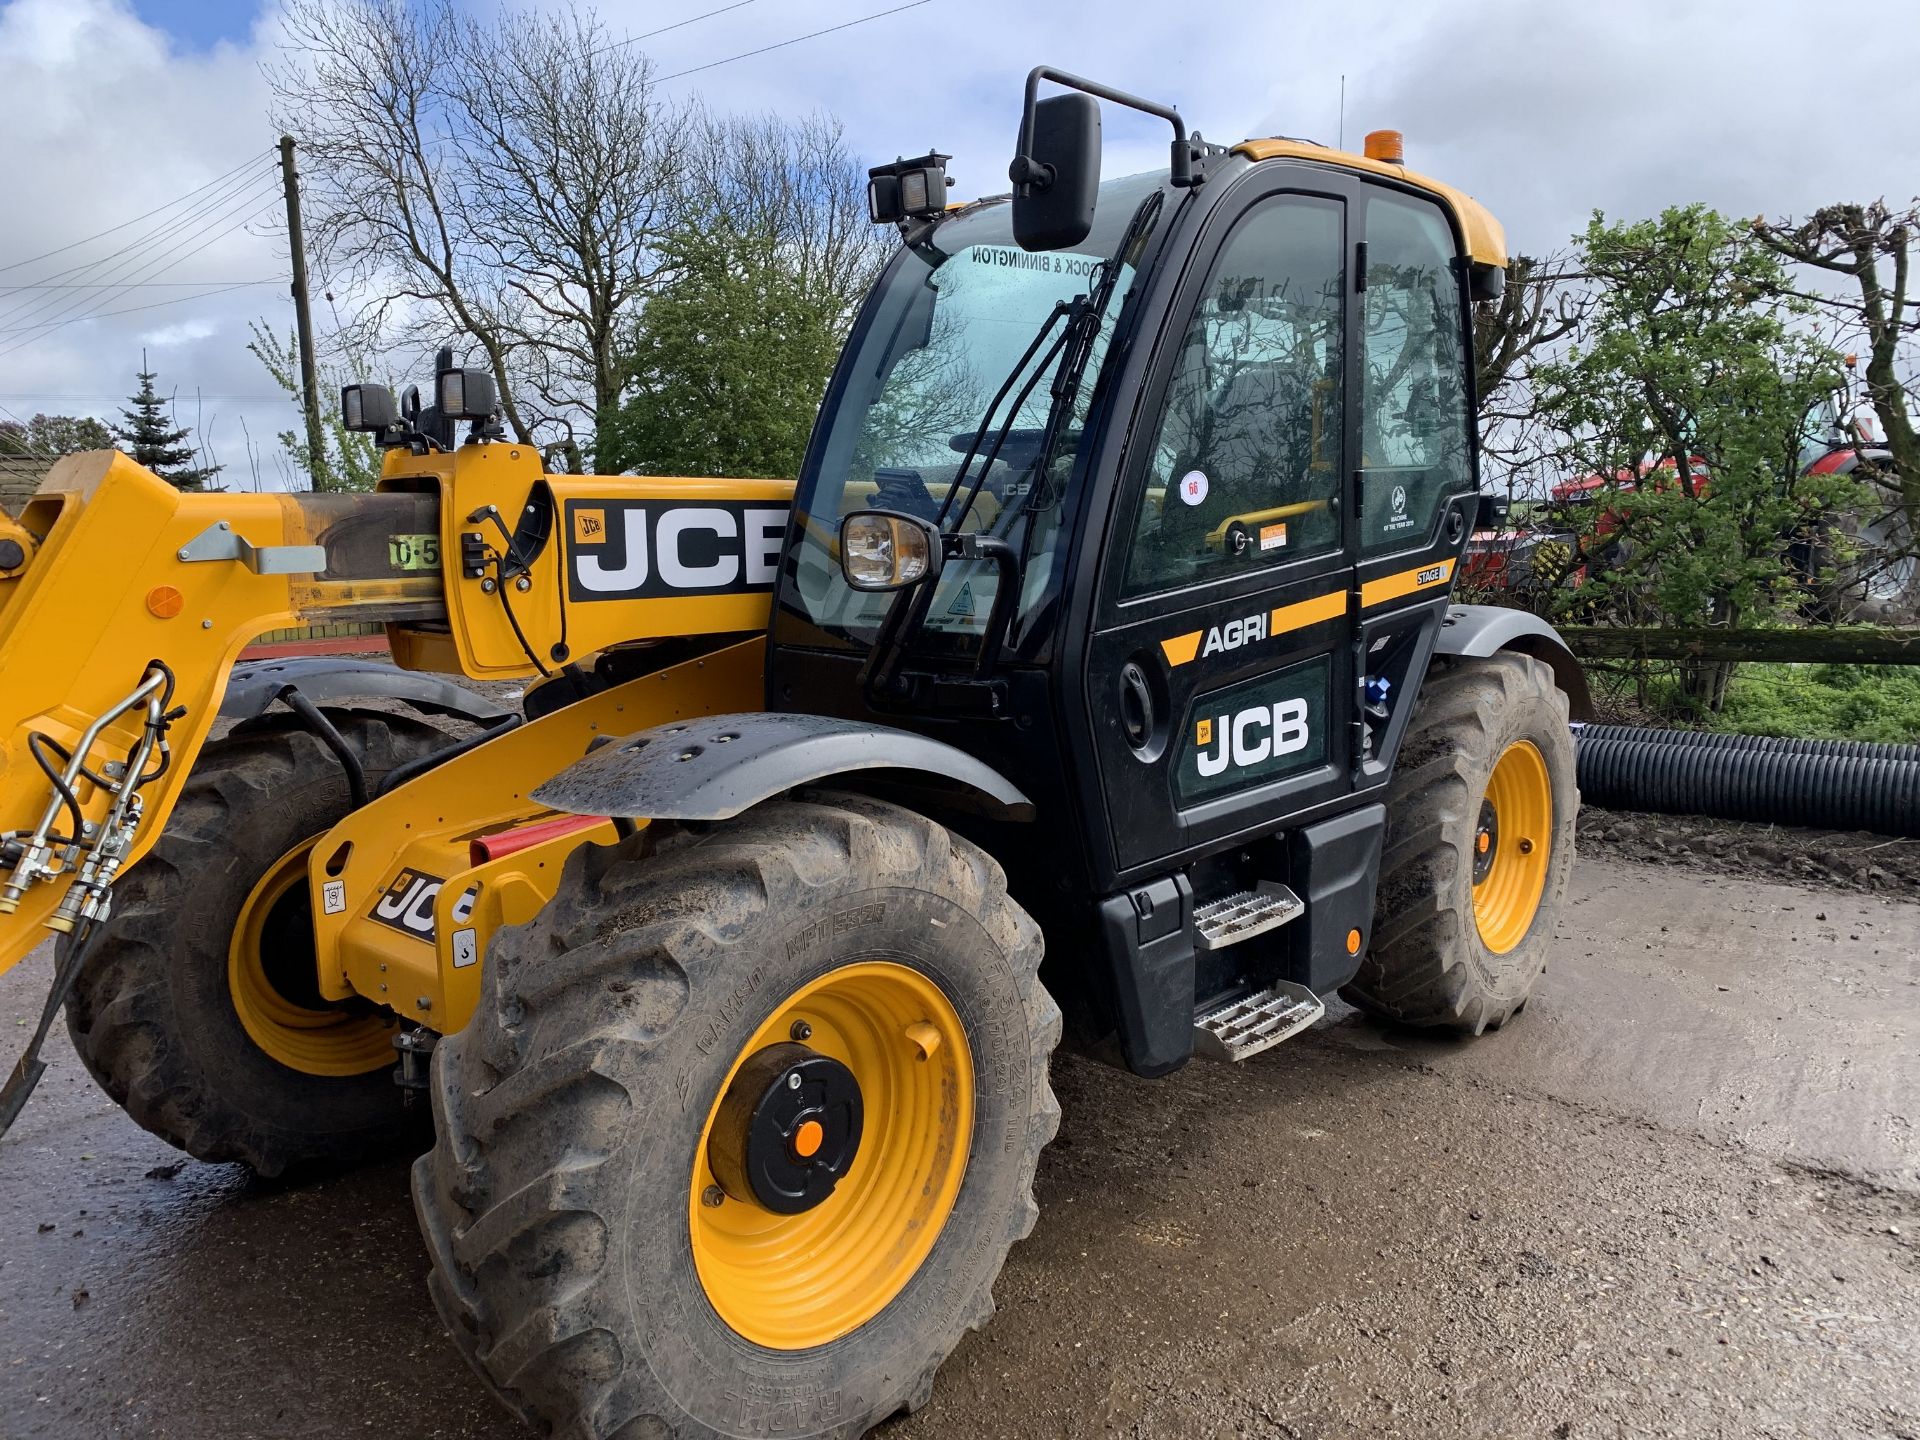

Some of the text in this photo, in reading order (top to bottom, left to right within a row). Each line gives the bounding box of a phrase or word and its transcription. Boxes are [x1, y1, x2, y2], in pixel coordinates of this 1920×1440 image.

[1188, 481, 1198, 495] 66
[582, 518, 600, 534] JCB
[1418, 568, 1439, 585] STAGE
[1202, 612, 1267, 658] AGRI
[1197, 697, 1309, 777] JCB
[786, 918, 829, 962] MPT
